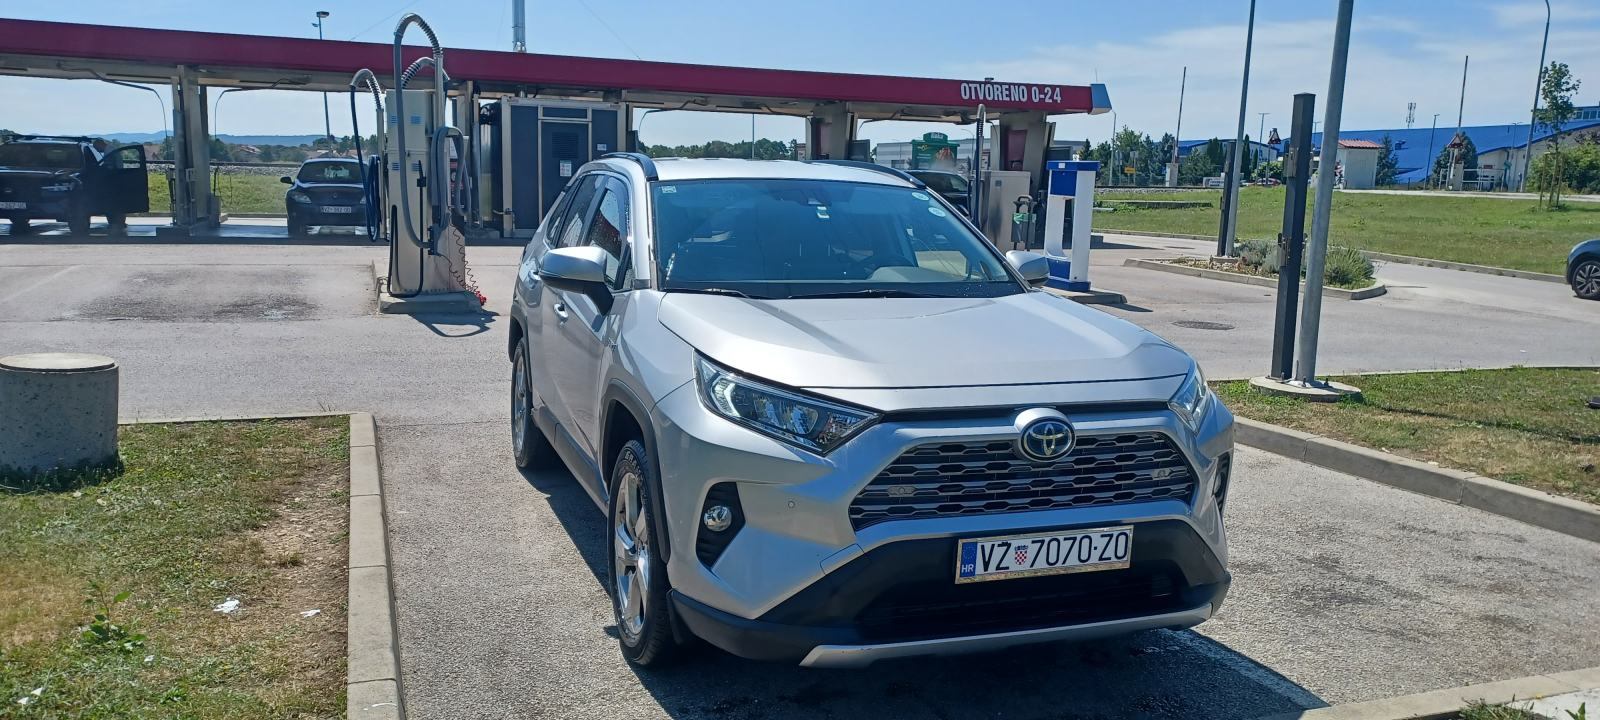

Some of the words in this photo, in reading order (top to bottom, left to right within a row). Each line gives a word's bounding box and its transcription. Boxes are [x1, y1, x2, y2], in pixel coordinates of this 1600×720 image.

[960, 83, 1028, 102] OTVORENO
[1031, 87, 1062, 103] 0-24
[980, 541, 1012, 572] VŽ
[961, 563, 974, 573] HR
